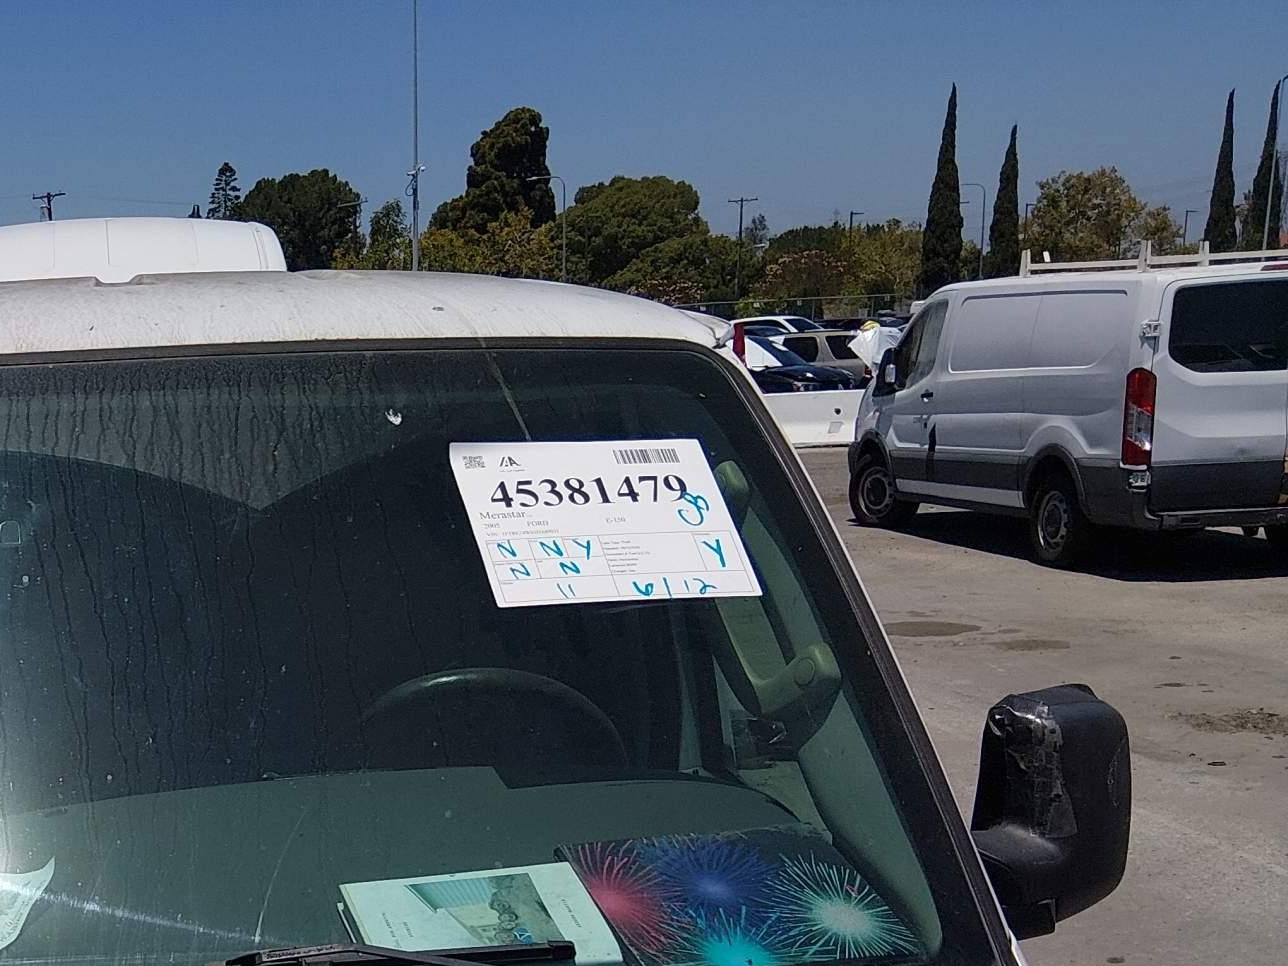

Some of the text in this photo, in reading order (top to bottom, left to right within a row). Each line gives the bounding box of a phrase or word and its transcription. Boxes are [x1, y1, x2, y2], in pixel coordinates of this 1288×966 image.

[491, 474, 687, 508] 45381479
[479, 511, 526, 521] Merastar
[701, 538, 727, 568] Y
